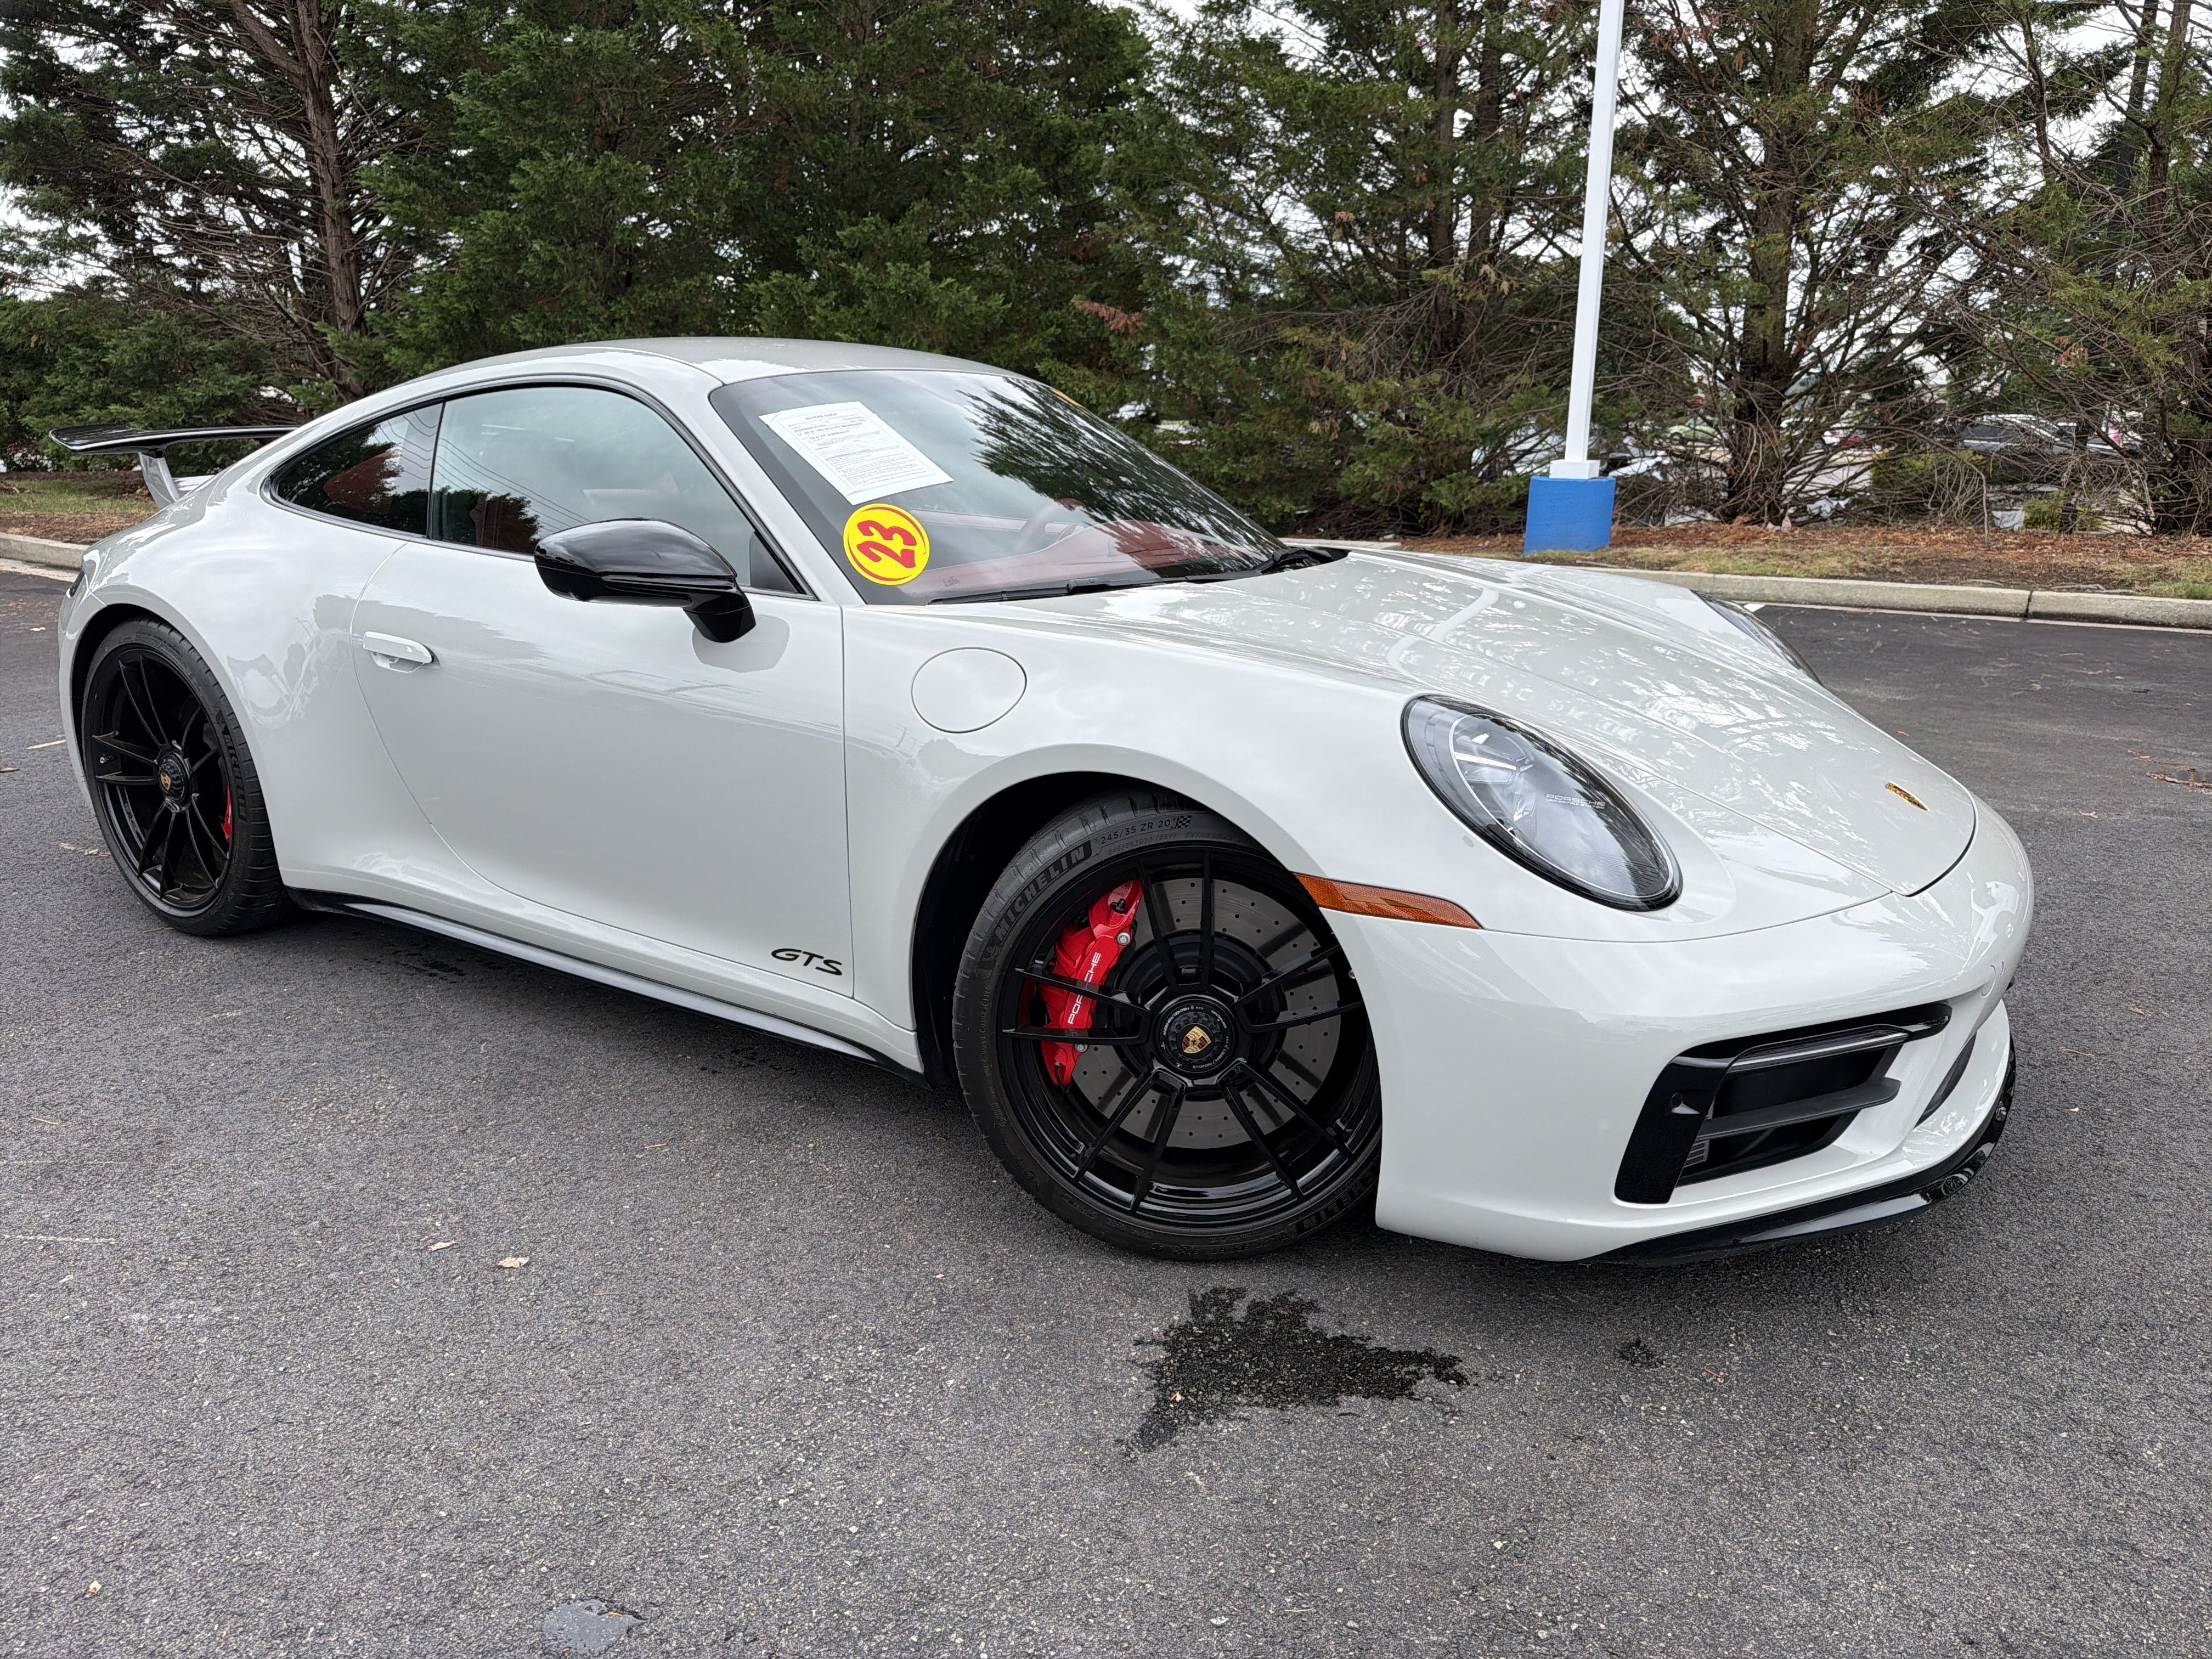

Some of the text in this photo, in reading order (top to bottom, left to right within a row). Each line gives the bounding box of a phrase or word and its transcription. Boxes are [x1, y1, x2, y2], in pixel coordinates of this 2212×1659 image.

[856, 520, 917, 568] 23
[1546, 794, 1606, 806] PORSCHE
[1101, 820, 1170, 844] 245/35 ZR 20
[995, 845, 1085, 942] MICHELIN
[771, 948, 843, 976] GTS
[1067, 951, 1102, 1025] PORCHE
